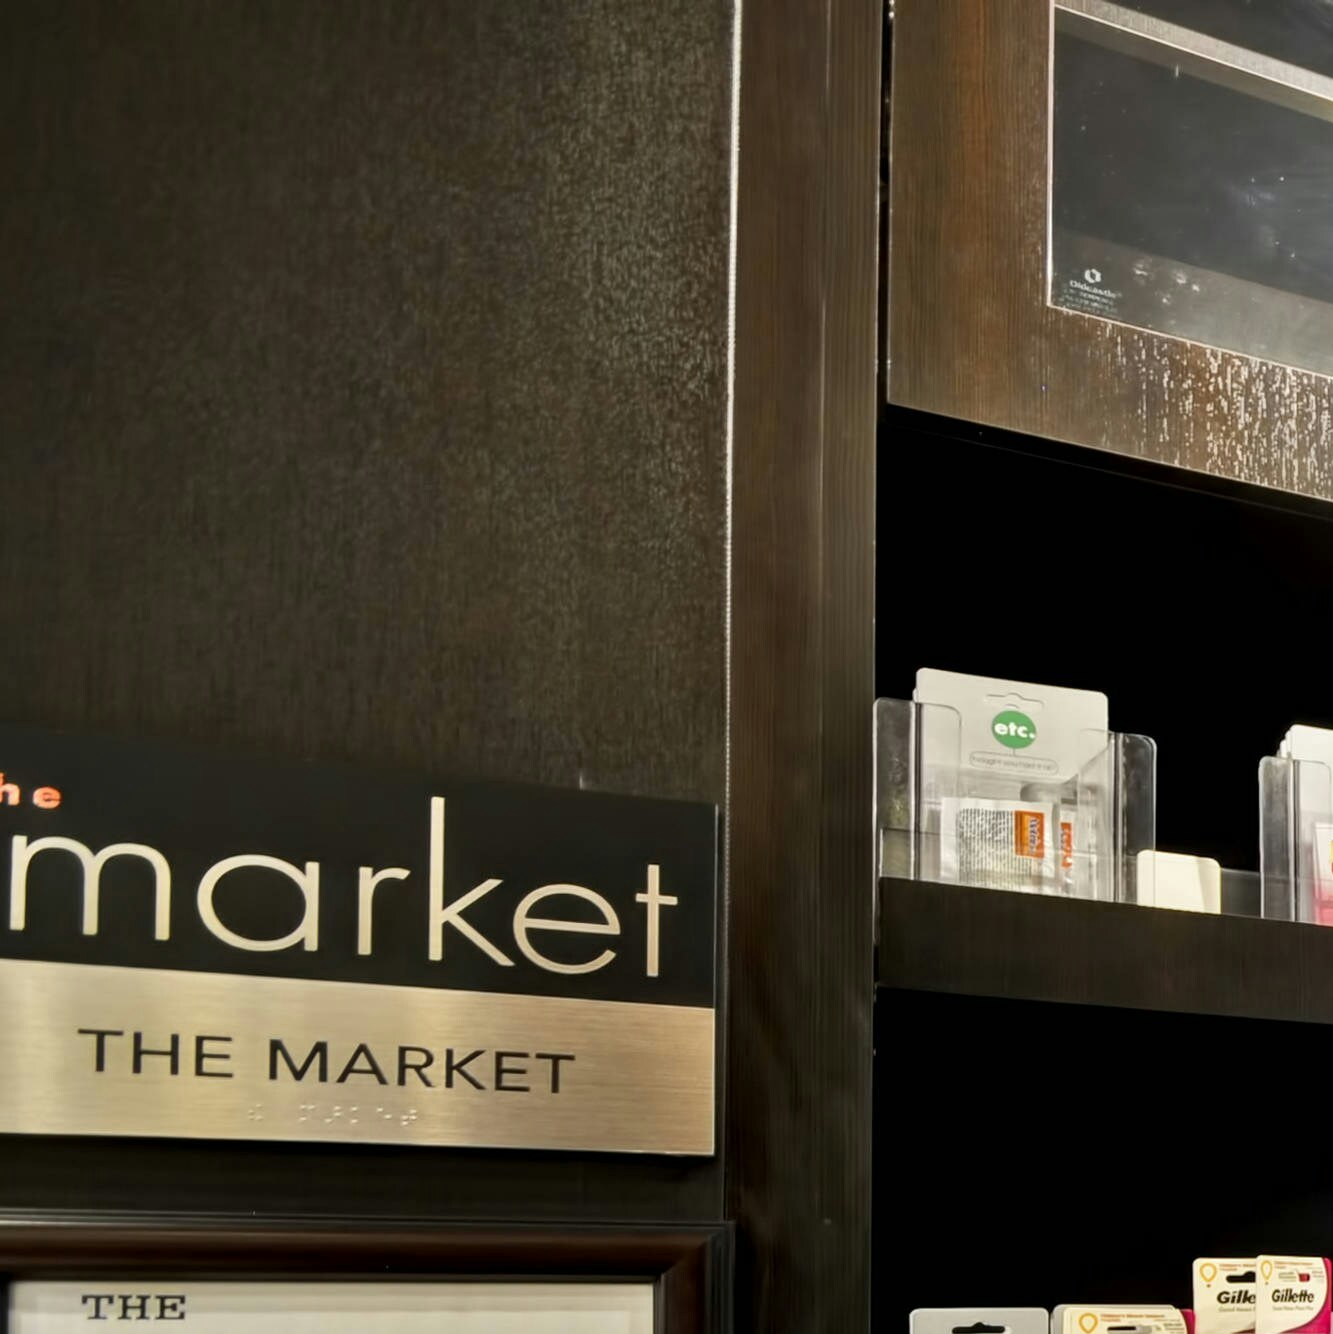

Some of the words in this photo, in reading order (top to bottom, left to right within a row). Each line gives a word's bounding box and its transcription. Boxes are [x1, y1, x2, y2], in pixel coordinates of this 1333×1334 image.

[993, 721, 1036, 740] etc.
[9, 797, 679, 977] market
[78, 1028, 235, 1079] THE
[268, 1038, 576, 1094] MARKET
[81, 1294, 187, 1320] THE
[1271, 1288, 1315, 1303] Gillette
